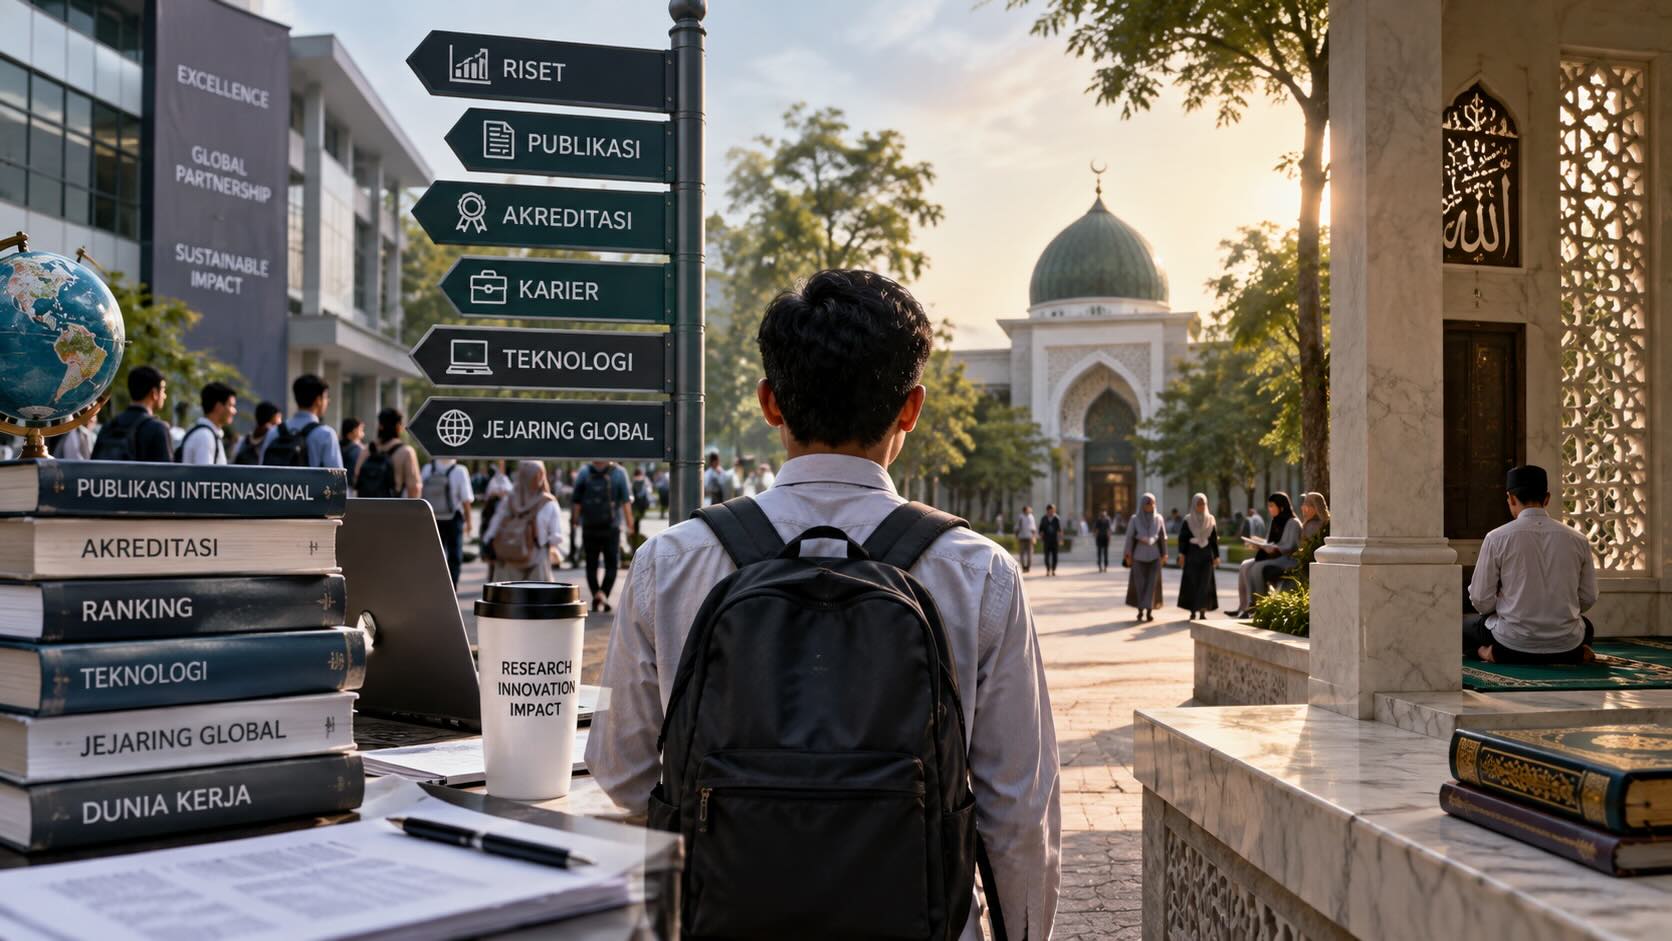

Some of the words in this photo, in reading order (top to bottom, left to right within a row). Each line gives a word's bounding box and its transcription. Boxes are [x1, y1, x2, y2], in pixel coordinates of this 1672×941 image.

[503, 59, 566, 82] RISET
[177, 64, 270, 109] EXCELLENCE
[528, 133, 641, 159] PUBLIKASI
[191, 145, 247, 177] GLOBAL
[176, 164, 271, 203] PARTNERSHIP
[502, 206, 632, 230] AKREDITASI
[176, 243, 269, 278] SUSTAINABLE
[191, 270, 243, 295] IMPACT
[519, 279, 599, 301] KARIER
[503, 349, 633, 371] TEKNOLOGI
[483, 420, 574, 440] JEJARING
[580, 422, 654, 441] GLOBAL
[77, 478, 175, 498] PUBLIKASI
[181, 481, 314, 501] INTERNASIONAL
[81, 538, 218, 558] AKREDITASI
[82, 597, 193, 622] RANKING
[80, 661, 207, 689] TEKNOLOGI
[501, 660, 572, 676] RESEARCH
[498, 680, 576, 697] INNOVATION
[510, 702, 562, 717] IMPACT
[81, 728, 192, 757] JEJARING
[200, 719, 287, 746] GLOBAL
[82, 794, 169, 825] DUNIA
[177, 784, 252, 812] KERJA
